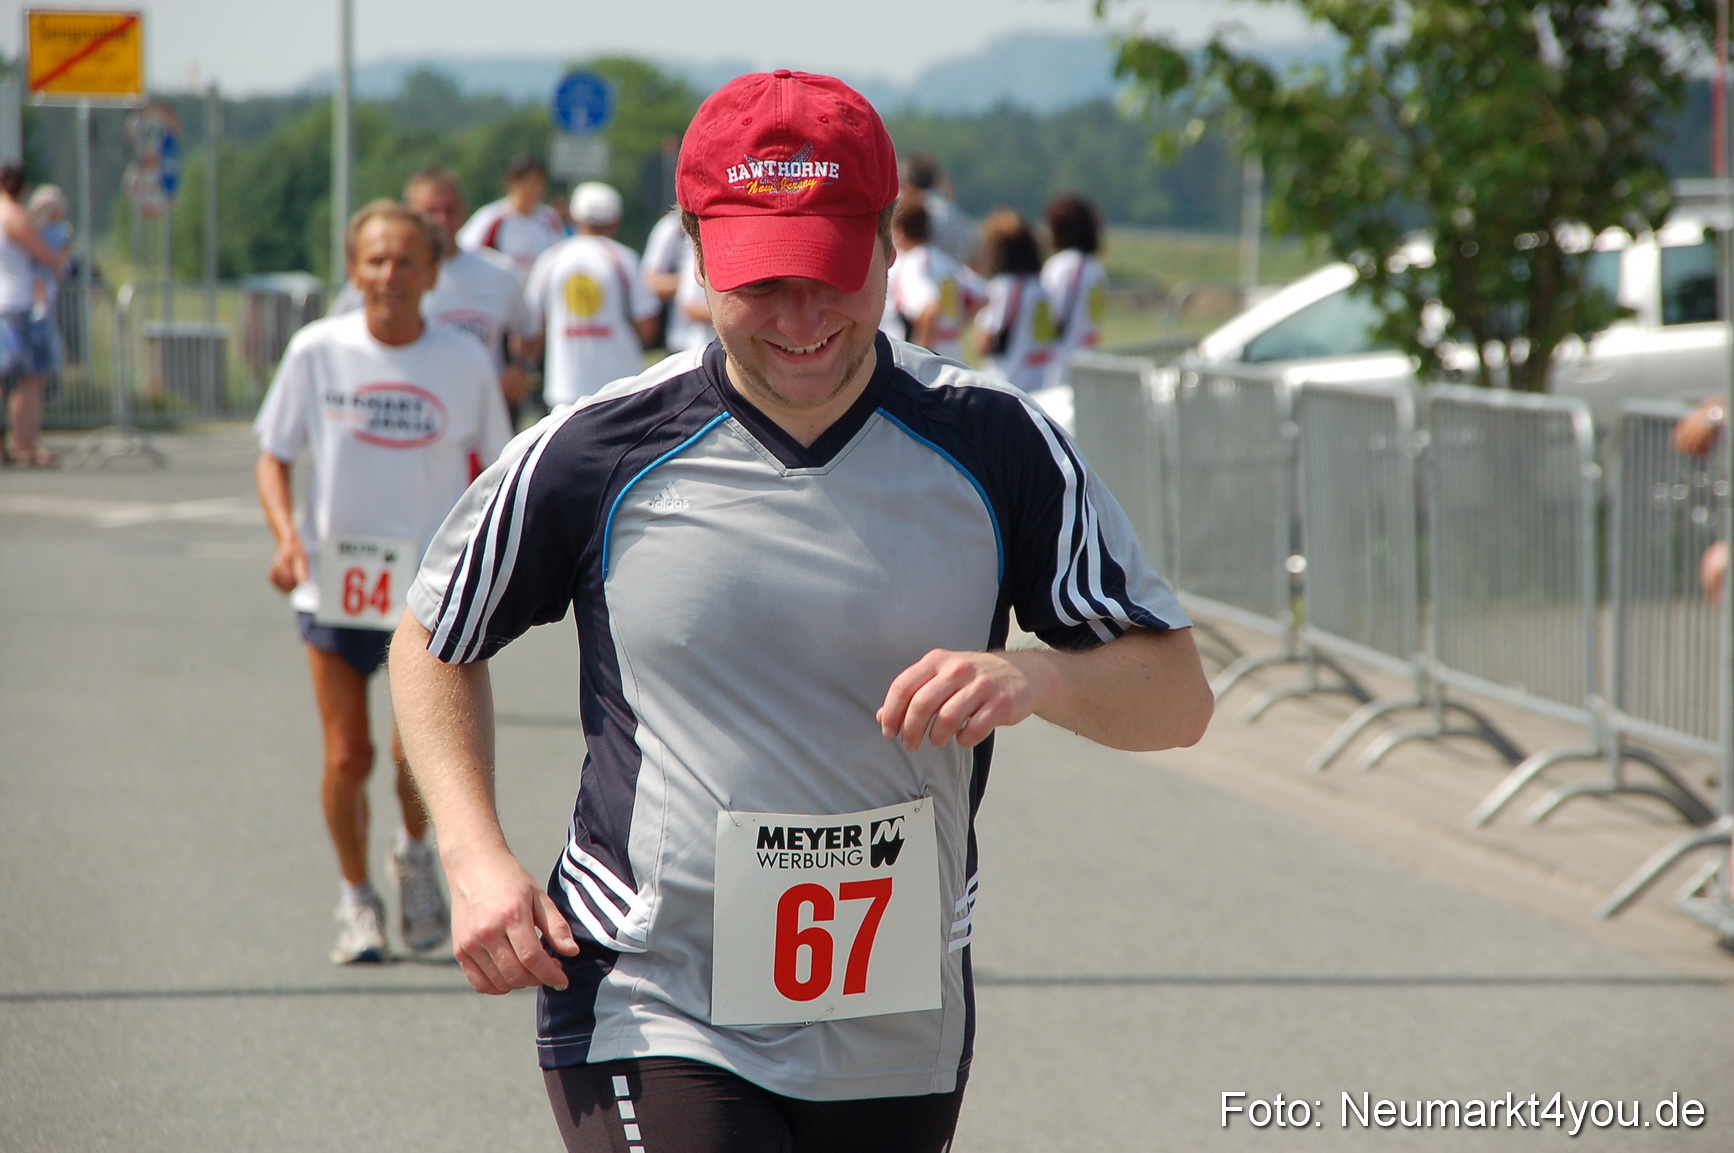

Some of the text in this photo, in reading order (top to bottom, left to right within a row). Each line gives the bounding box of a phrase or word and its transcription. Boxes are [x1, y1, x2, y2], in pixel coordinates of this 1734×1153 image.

[726, 160, 840, 184] HAWTHORNE
[746, 177, 817, 195] New Jersey
[647, 497, 689, 509] adidas
[343, 566, 391, 616] 64
[756, 824, 863, 850] MEYER
[756, 849, 864, 869] WERBUNG
[773, 876, 893, 1002] 67
